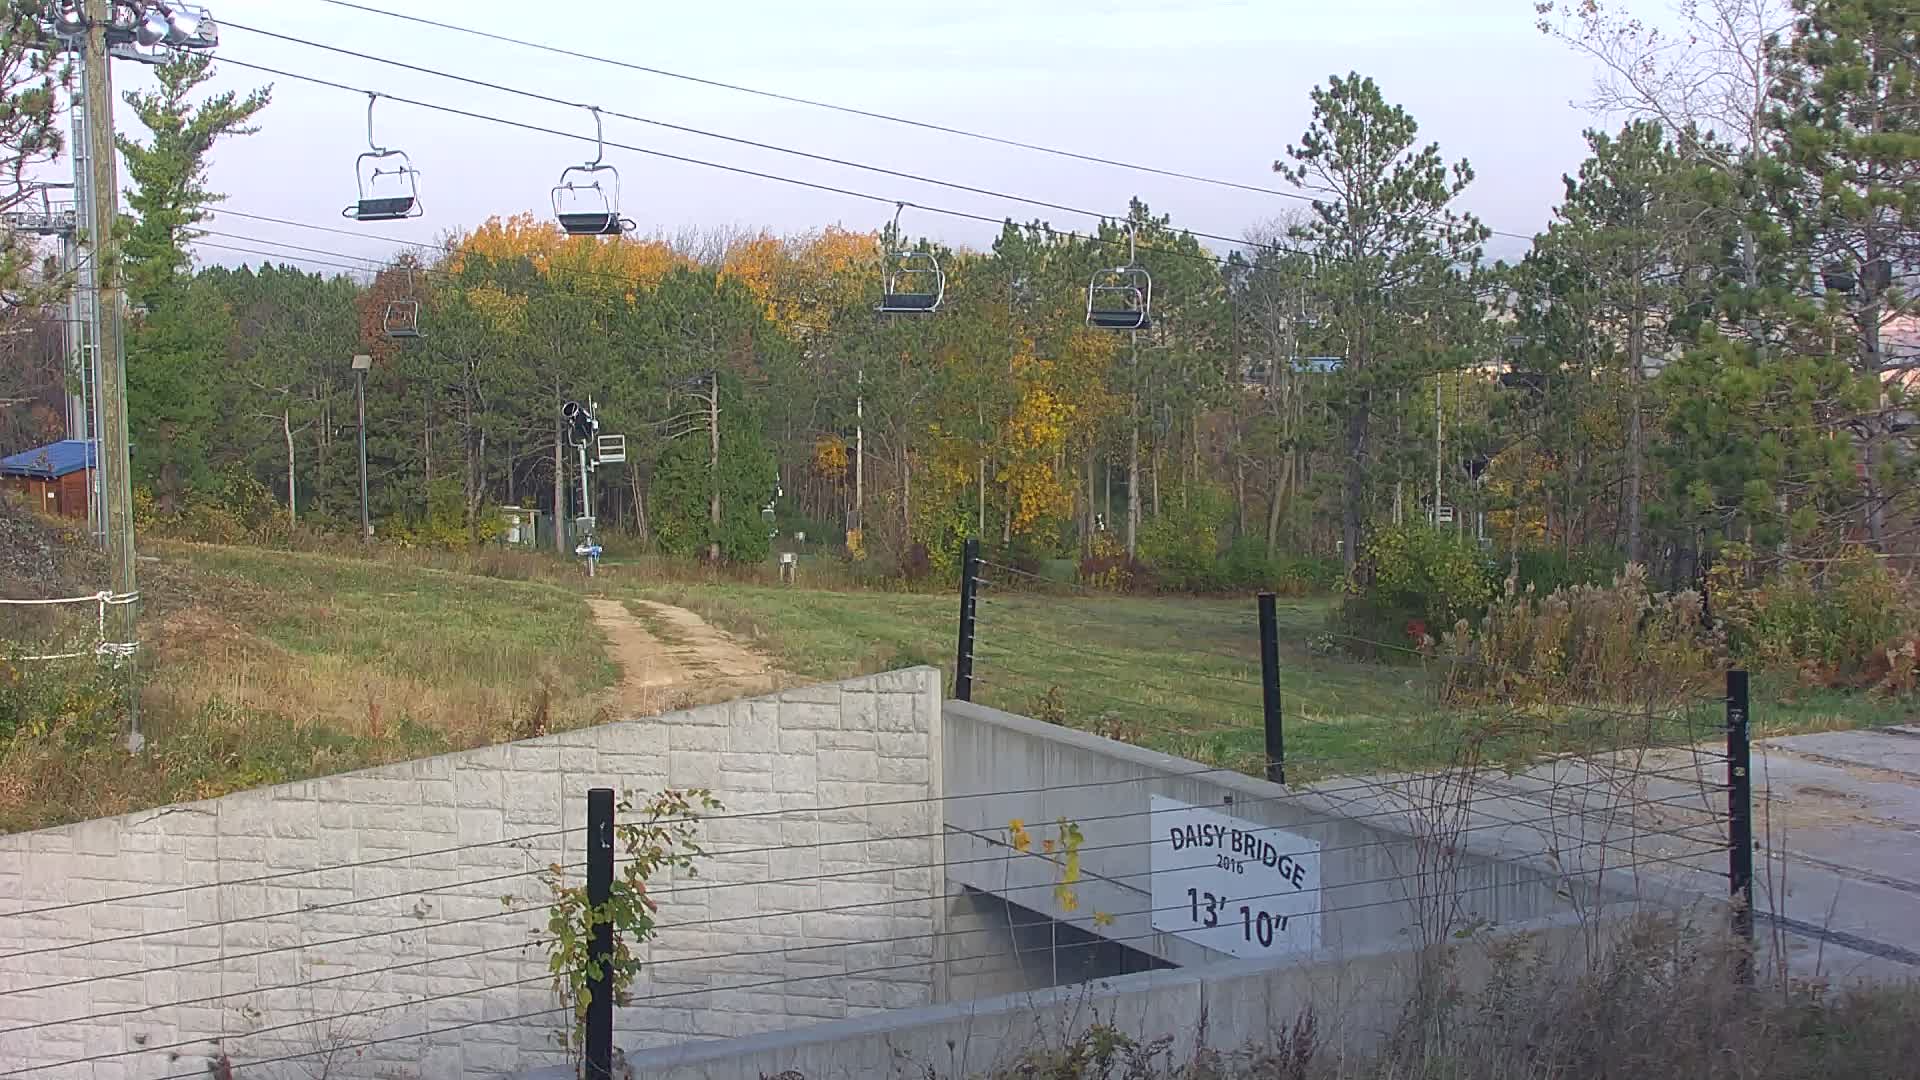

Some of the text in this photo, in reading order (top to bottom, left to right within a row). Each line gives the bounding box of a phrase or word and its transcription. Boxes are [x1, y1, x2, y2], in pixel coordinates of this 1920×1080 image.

[1170, 824, 1306, 889] DAISY BRIDGE
[1216, 854, 1244, 875] 2016
[1187, 888, 1288, 948] 13' 10"
